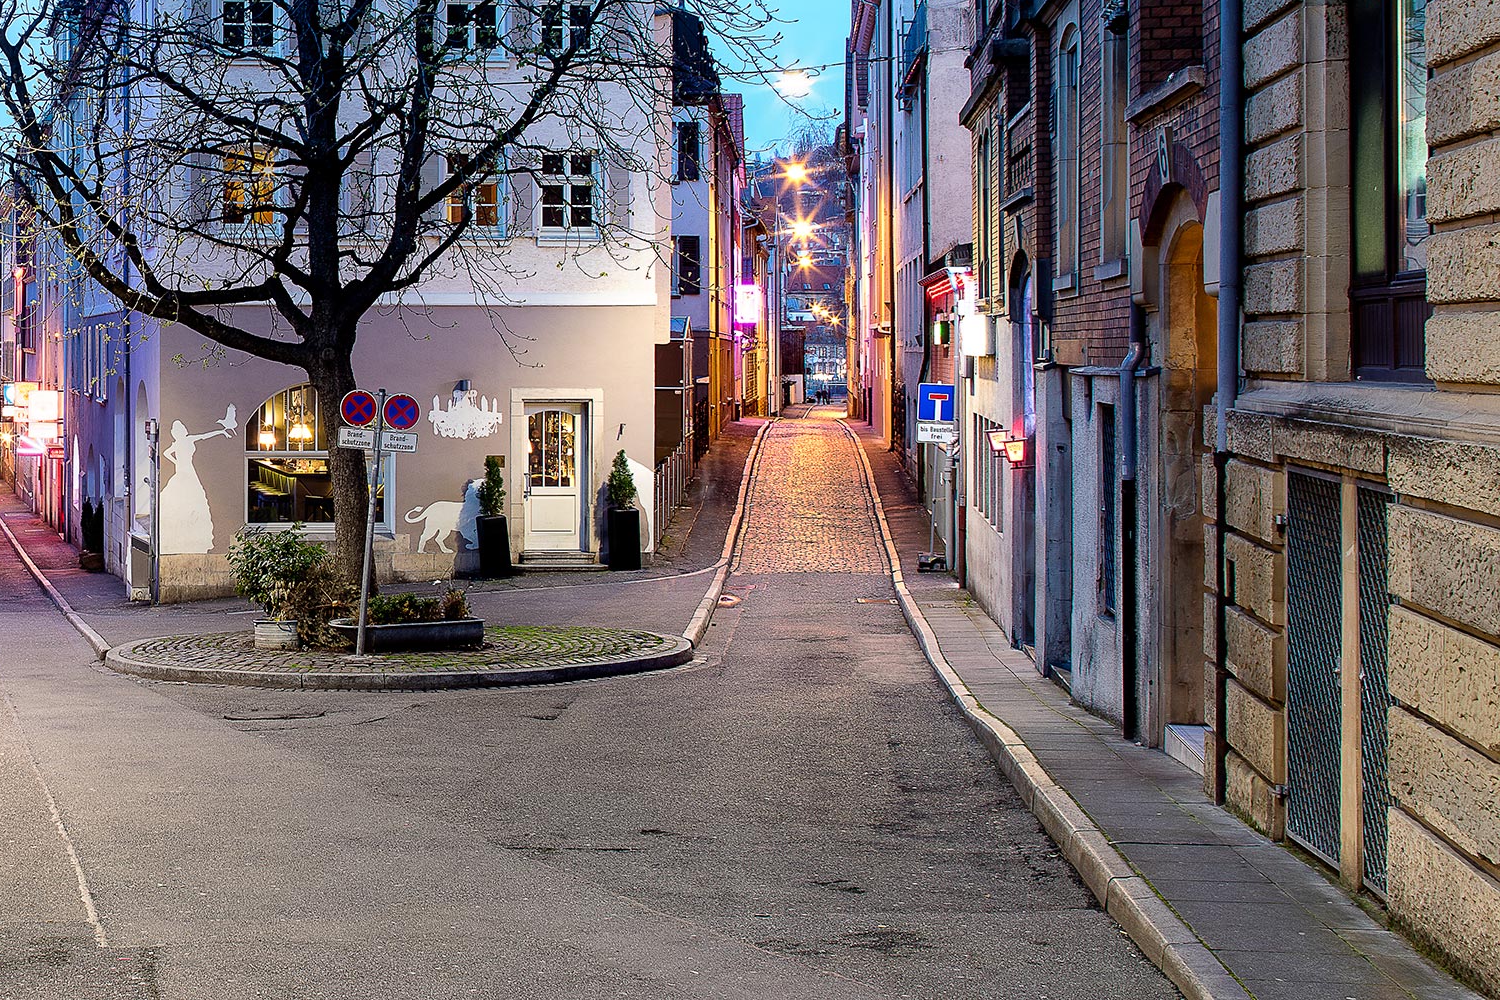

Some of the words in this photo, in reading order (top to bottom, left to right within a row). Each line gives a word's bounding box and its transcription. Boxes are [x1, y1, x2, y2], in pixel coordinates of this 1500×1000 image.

[347, 430, 366, 438] Brand-
[390, 434, 409, 442] Brand-
[341, 438, 371, 447] schutzzone
[384, 442, 414, 450] schutzzone
